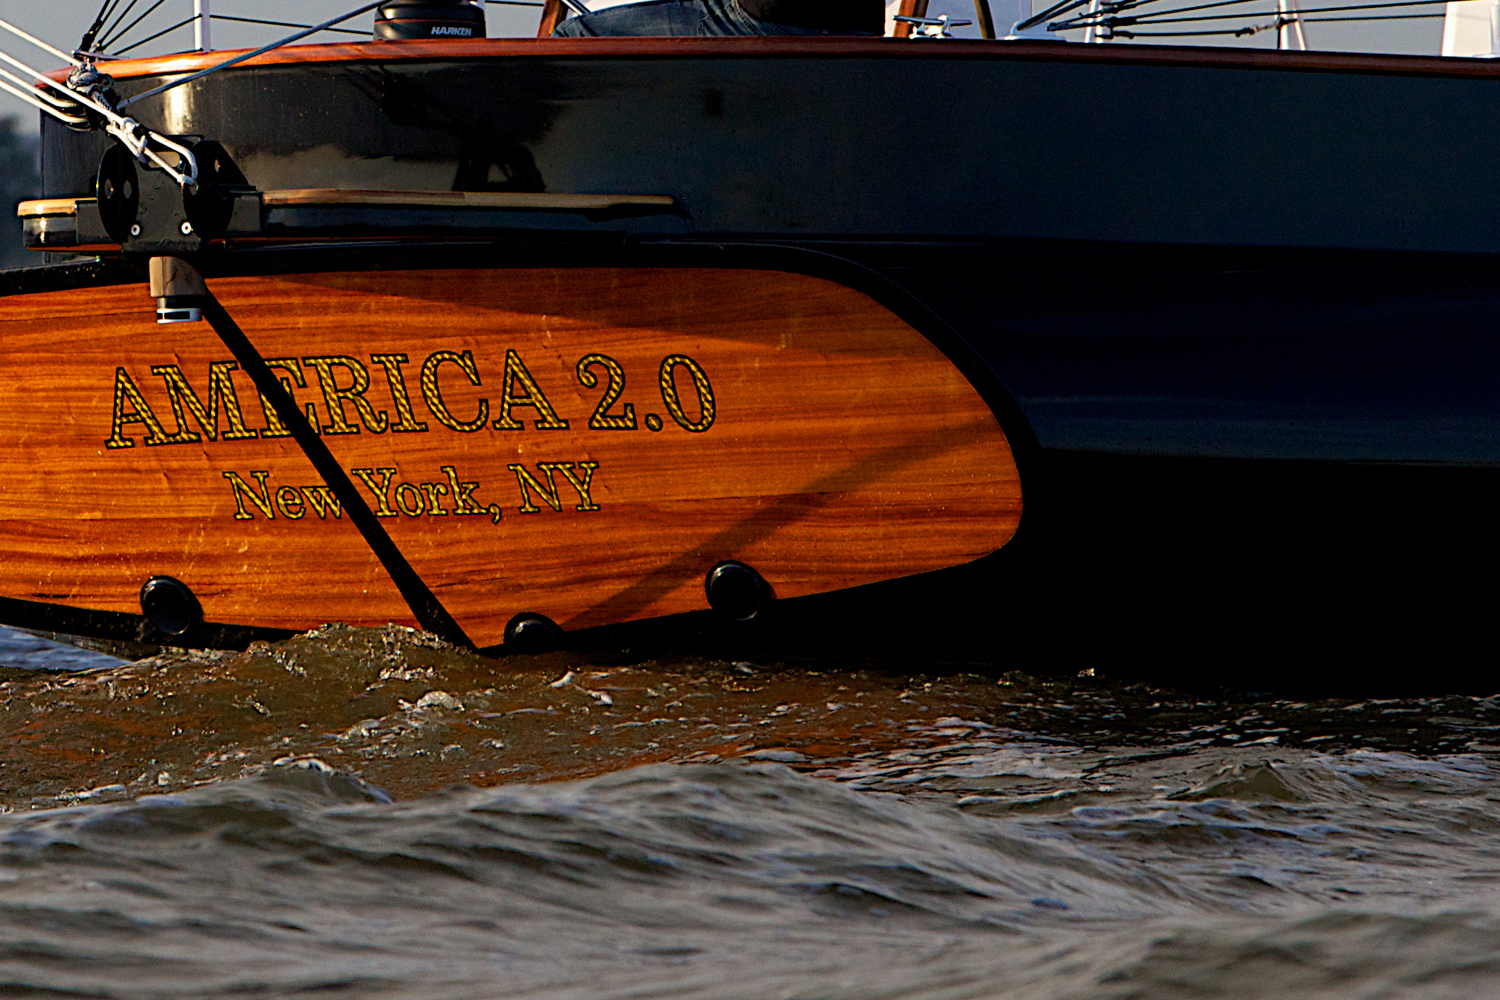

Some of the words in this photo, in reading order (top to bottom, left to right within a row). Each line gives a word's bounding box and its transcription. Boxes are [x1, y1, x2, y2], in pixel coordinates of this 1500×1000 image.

[431, 26, 472, 36] HARKEN
[105, 349, 570, 449] AMERICA
[577, 353, 716, 433] 2.0
[222, 470, 344, 520] New
[351, 465, 502, 525] York,
[508, 461, 600, 514] NY
